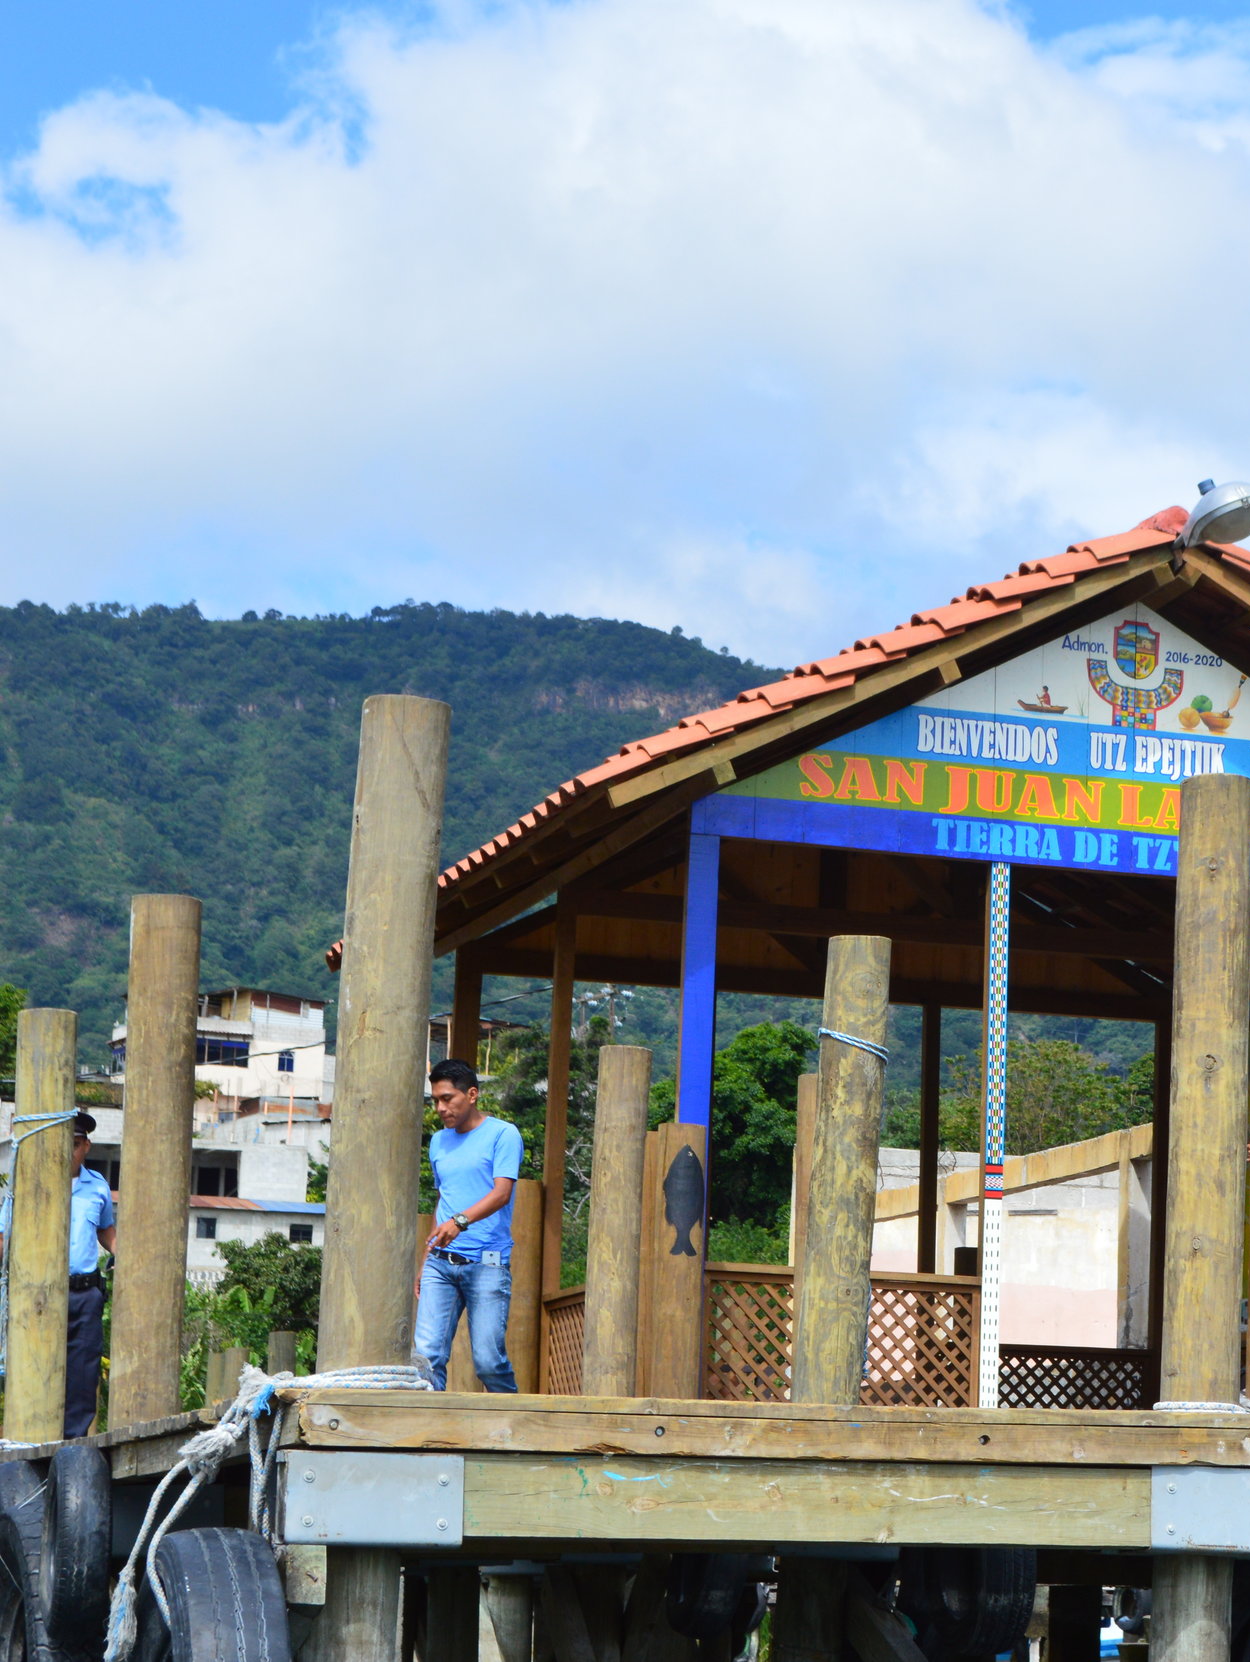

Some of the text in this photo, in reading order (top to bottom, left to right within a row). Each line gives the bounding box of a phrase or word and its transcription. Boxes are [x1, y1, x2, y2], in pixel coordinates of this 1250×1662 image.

[1061, 634, 1223, 668] Admon. 2016-2020
[916, 714, 1059, 766] BIENVENIDOS
[1089, 732, 1128, 772] UTZ
[799, 754, 928, 806] SAN
[938, 765, 1106, 823] JUAN
[1117, 784, 1180, 830] LA
[932, 818, 1062, 861] TIERRA
[1073, 831, 1119, 866] DE
